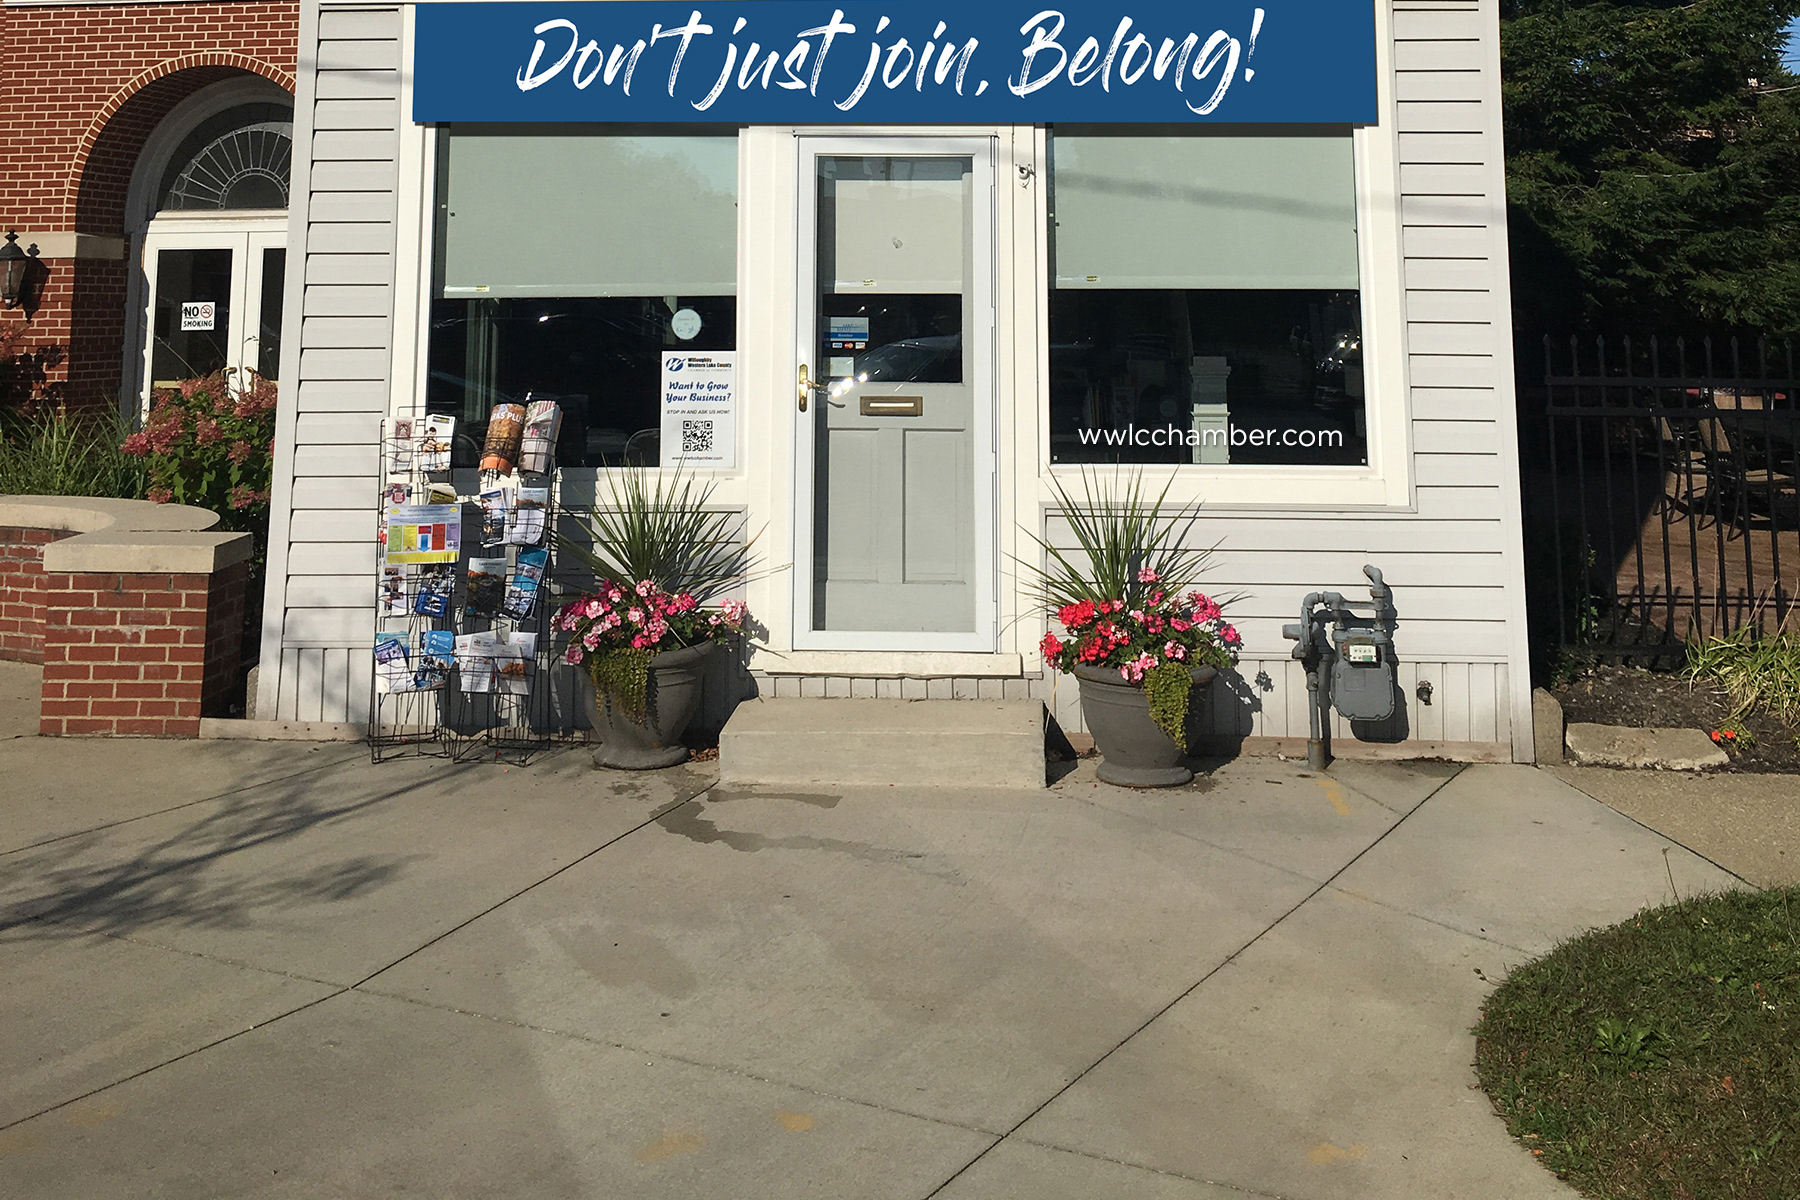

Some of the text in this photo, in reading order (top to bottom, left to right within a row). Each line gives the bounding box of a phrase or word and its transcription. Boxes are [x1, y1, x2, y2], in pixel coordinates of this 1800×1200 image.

[516, 8, 1266, 116] Don't just join, Belong!
[184, 306, 199, 317] NO
[707, 381, 729, 391] Grow
[666, 393, 732, 403] Your Business?
[507, 412, 525, 424] PLUS
[1078, 423, 1343, 447] wwlcchamber.com
